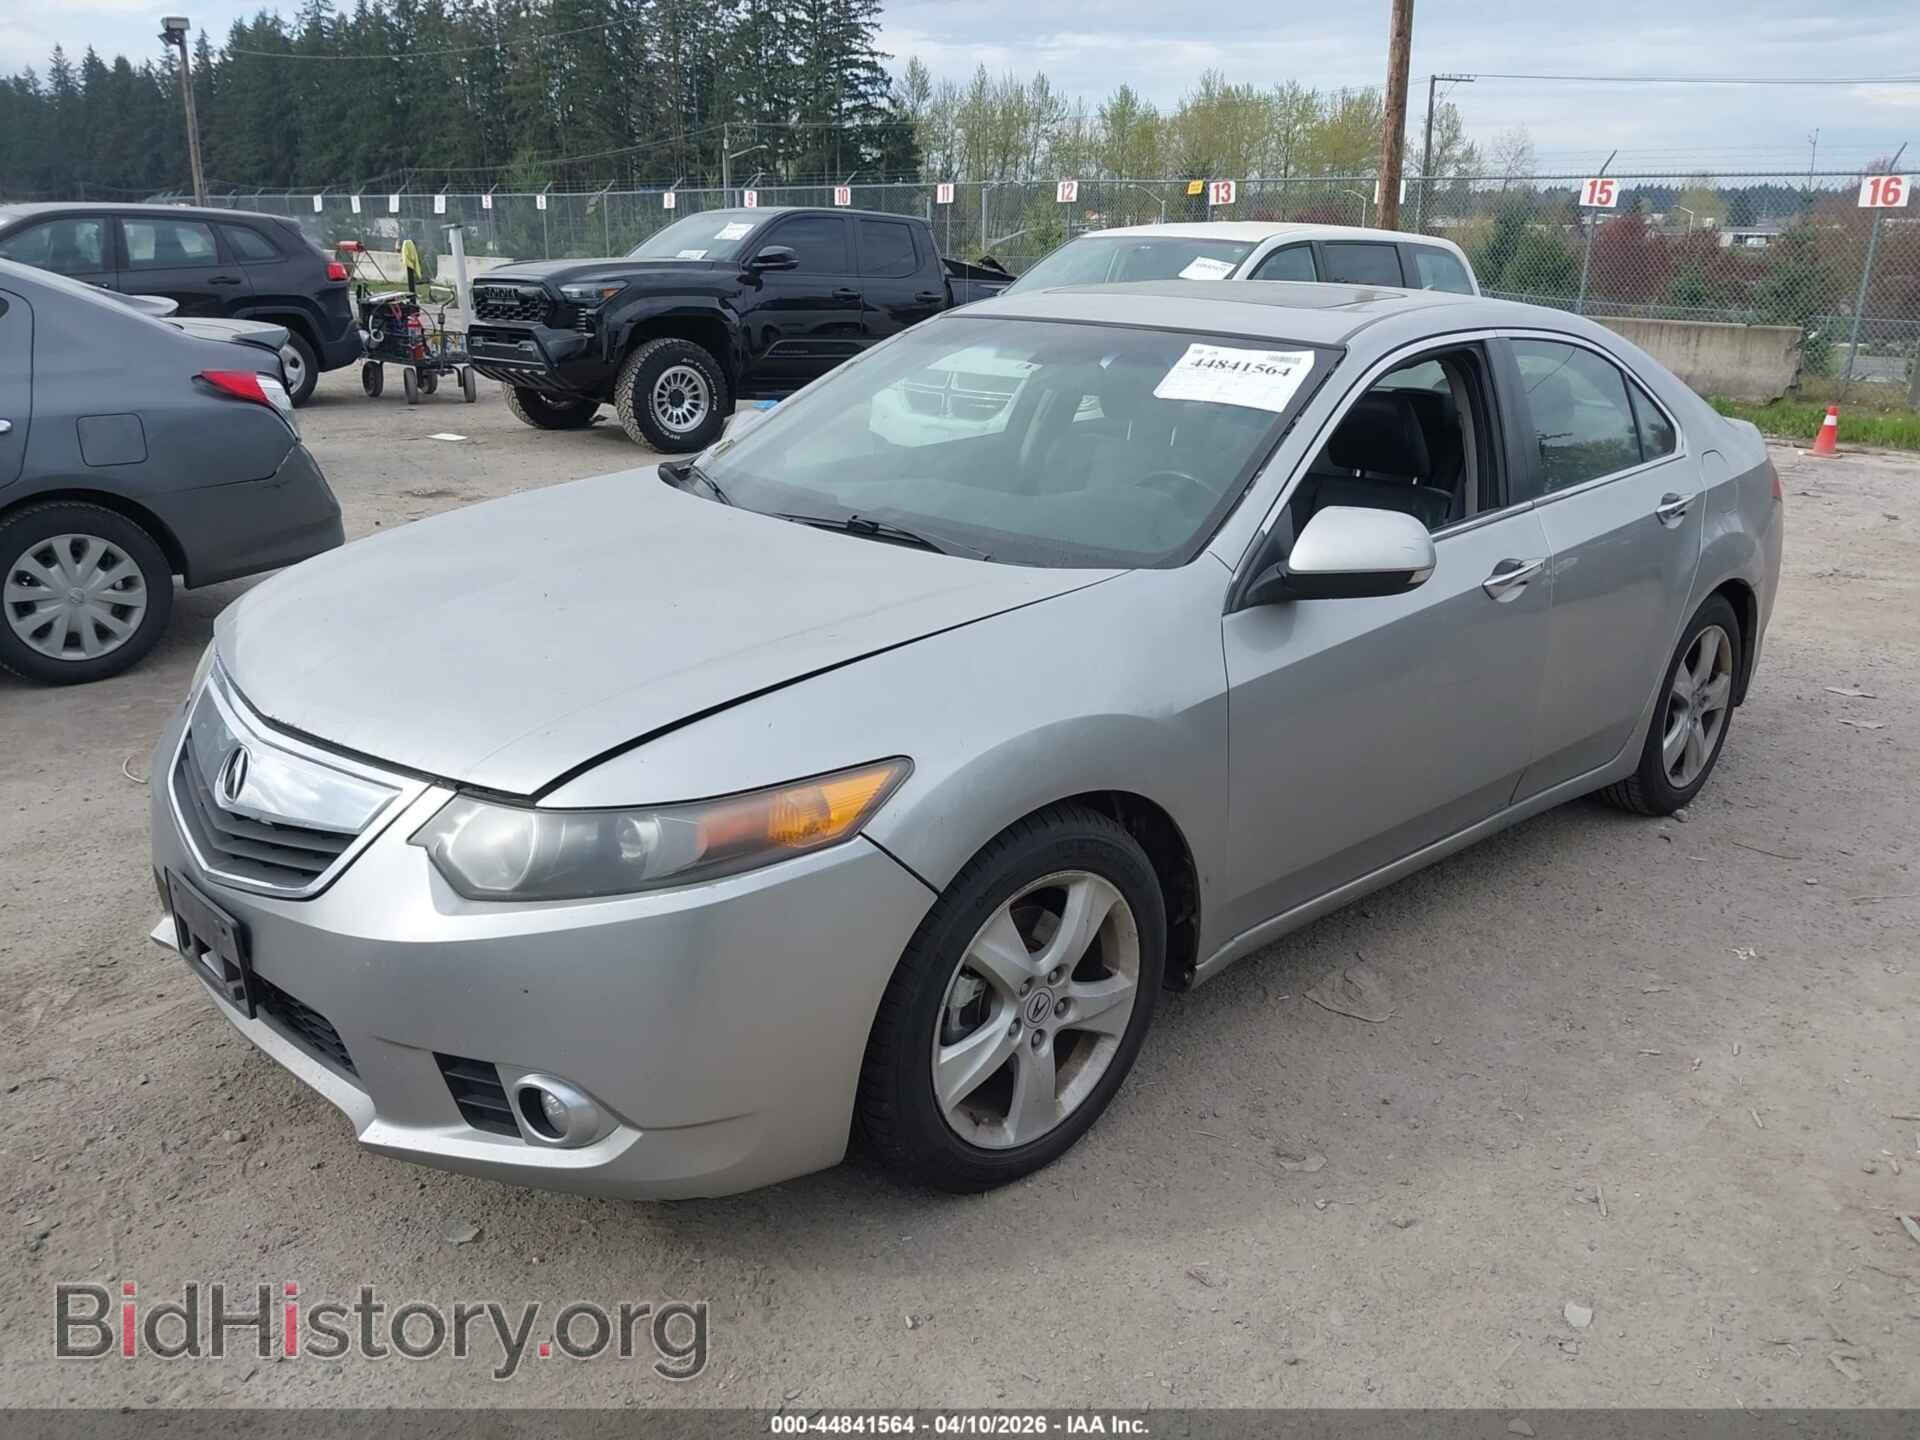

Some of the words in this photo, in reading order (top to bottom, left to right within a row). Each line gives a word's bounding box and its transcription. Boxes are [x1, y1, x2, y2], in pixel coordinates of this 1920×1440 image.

[747, 191, 754, 208] 9
[837, 187, 848, 204] 10
[941, 185, 949, 201] 11
[1061, 182, 1074, 201] 12
[1214, 182, 1231, 203] 13
[1588, 179, 1614, 205] 15
[1869, 176, 1902, 206] 16
[1190, 358, 1293, 378] 44841564
